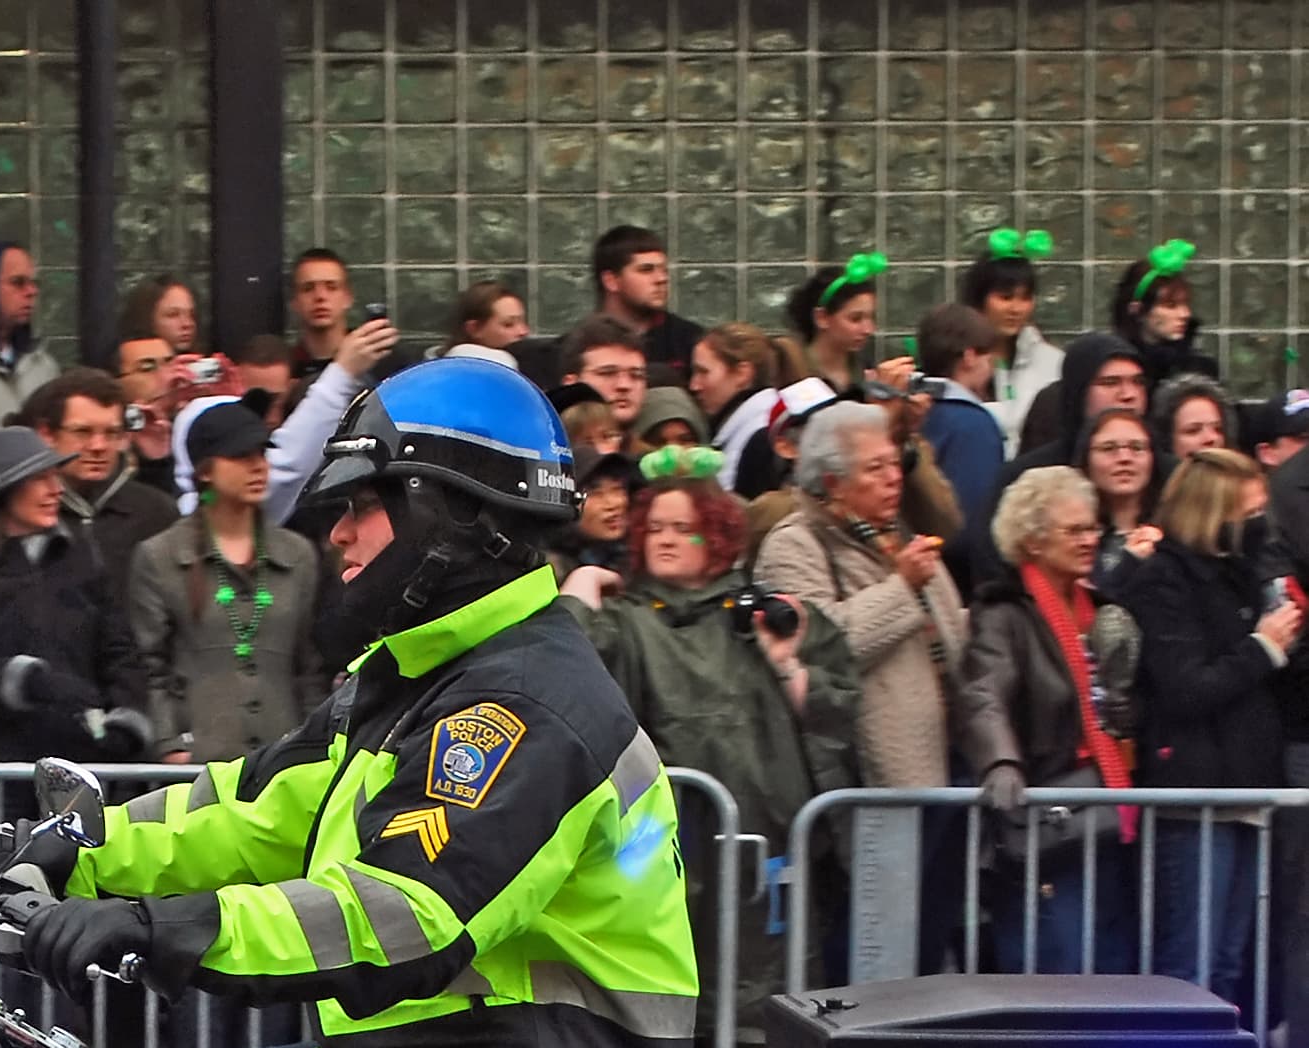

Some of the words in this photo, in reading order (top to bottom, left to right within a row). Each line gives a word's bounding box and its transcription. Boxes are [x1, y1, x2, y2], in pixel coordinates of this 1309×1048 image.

[446, 720, 504, 746] BOSTON
[450, 731, 494, 752] POLICE
[434, 779, 452, 793] A.D.
[454, 784, 477, 799] 1630
